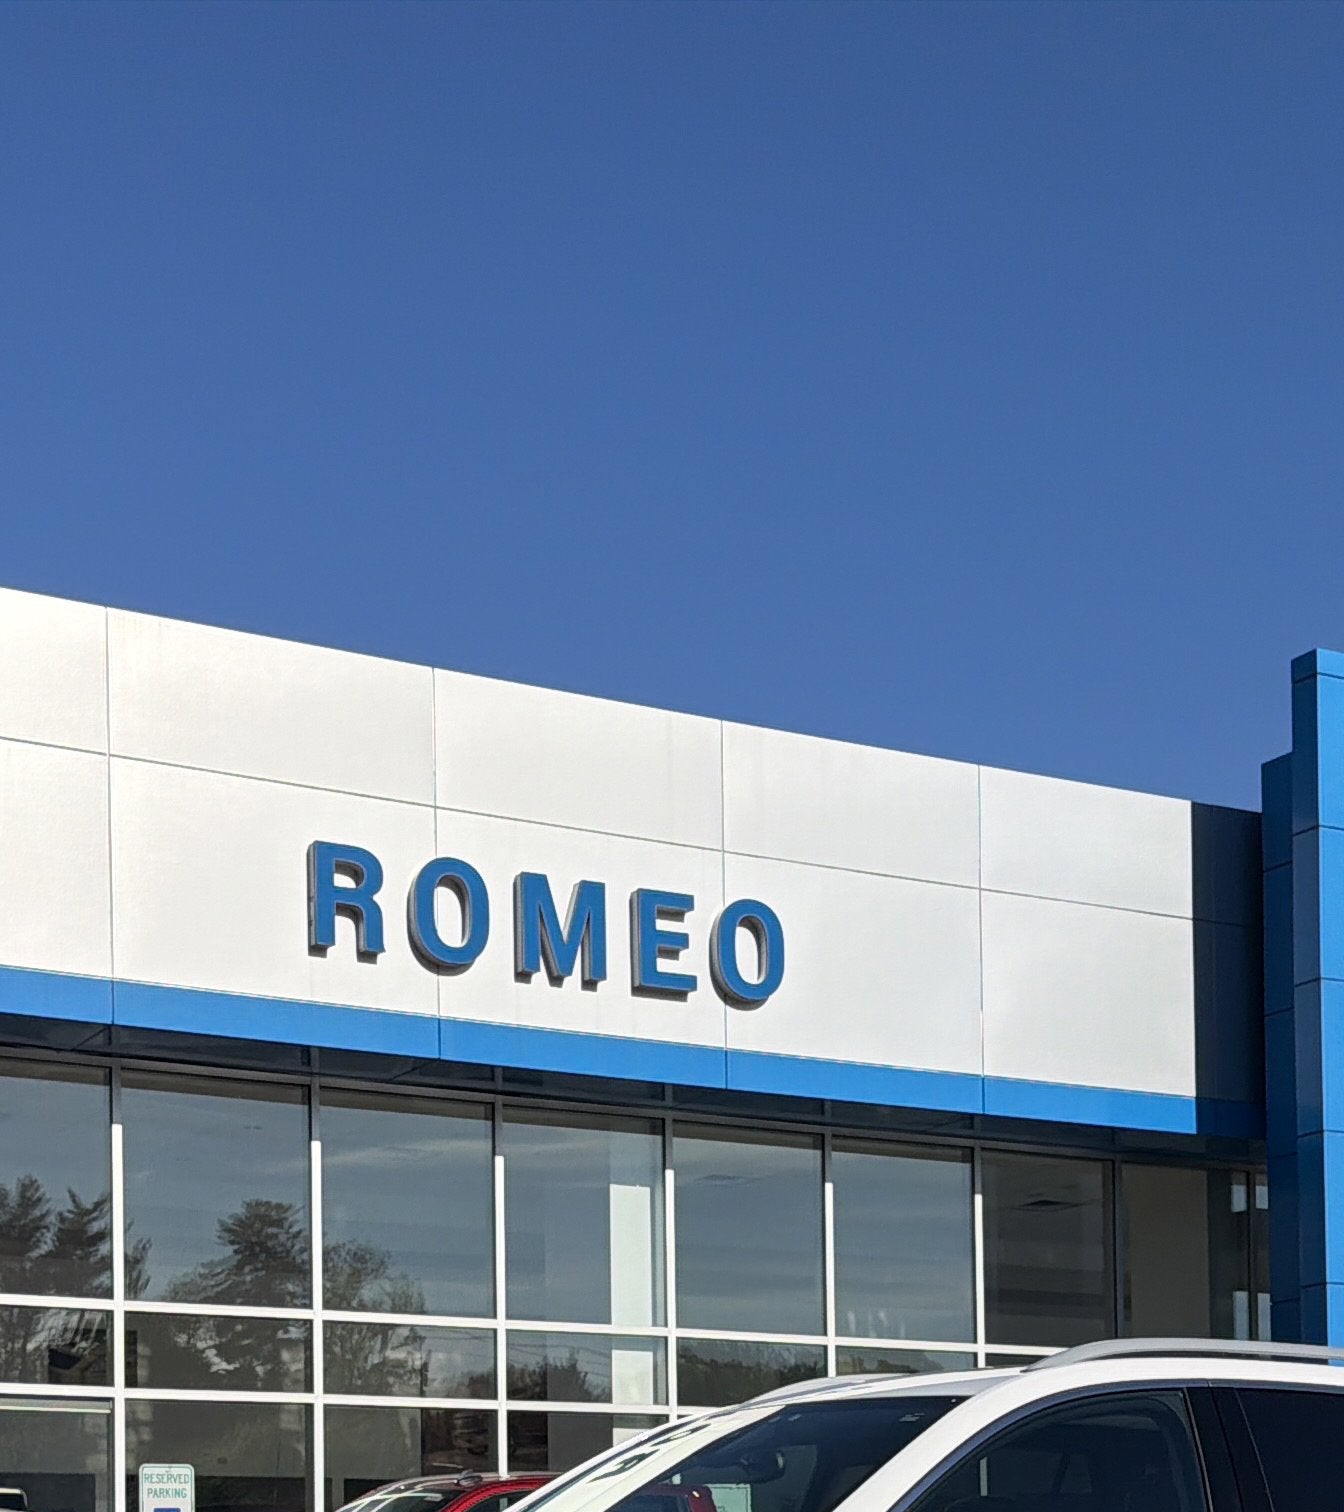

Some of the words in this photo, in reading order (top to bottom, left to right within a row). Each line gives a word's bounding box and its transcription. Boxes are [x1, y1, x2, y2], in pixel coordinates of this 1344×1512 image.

[309, 841, 785, 1003] ROMEO
[144, 1473, 190, 1484] RESERVED
[147, 1487, 188, 1499] PARKING
